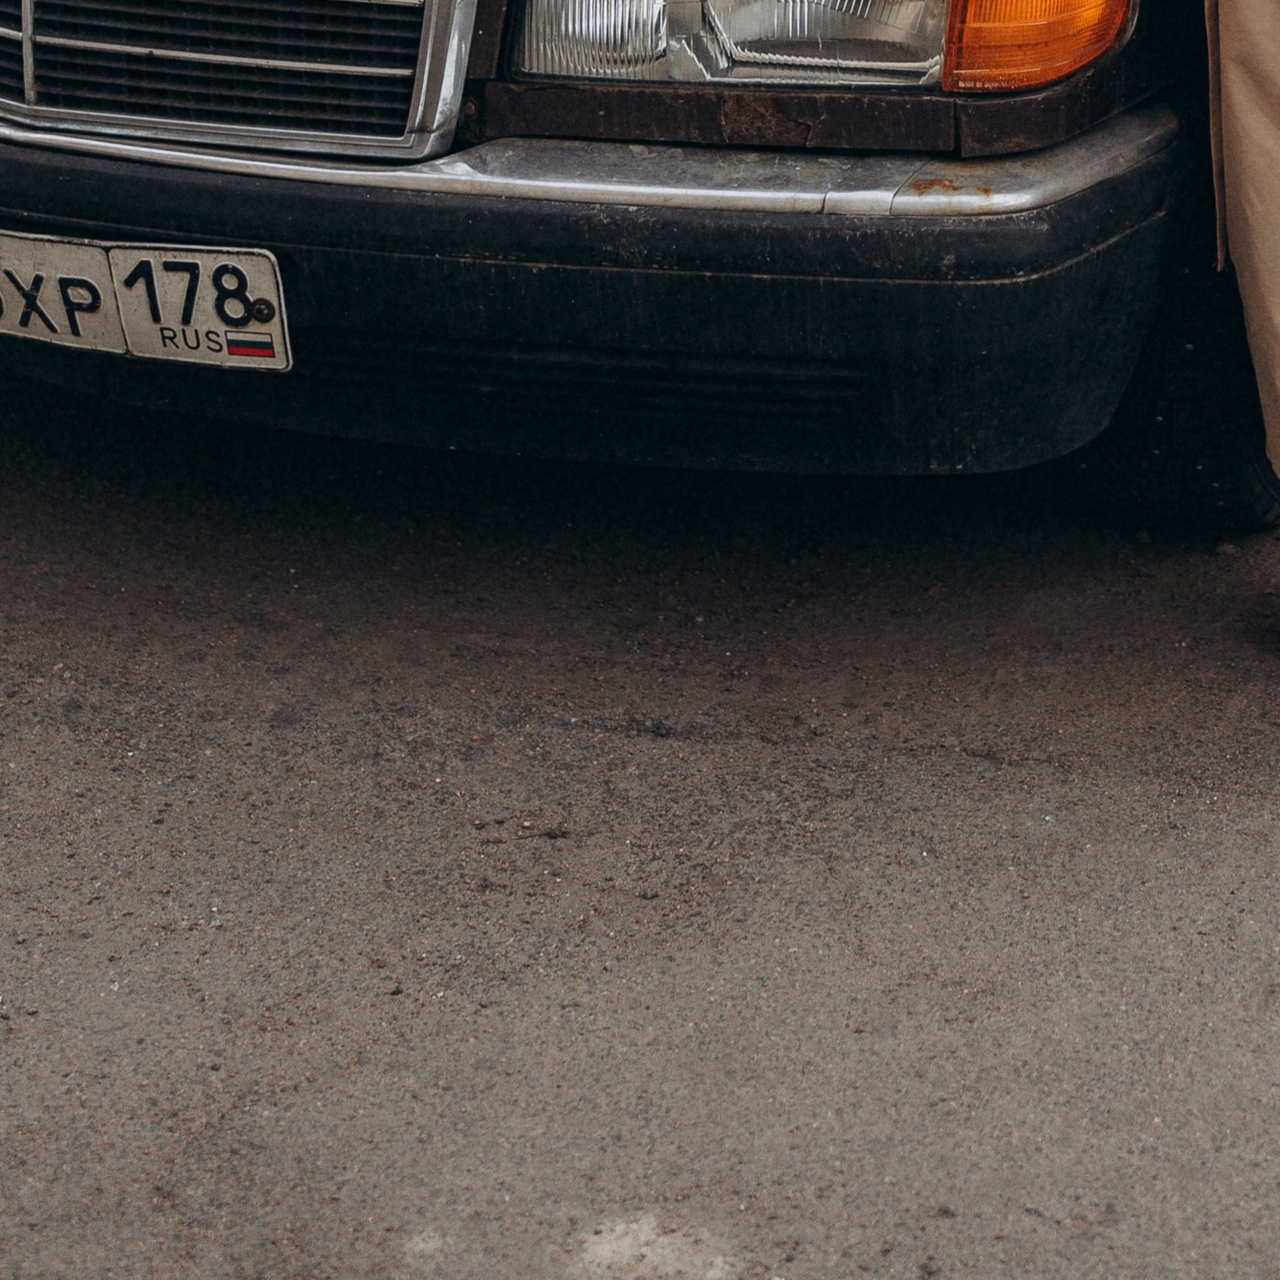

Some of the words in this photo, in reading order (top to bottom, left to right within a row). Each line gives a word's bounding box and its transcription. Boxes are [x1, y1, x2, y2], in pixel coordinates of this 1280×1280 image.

[0, 269, 101, 336] XP
[123, 259, 253, 327] 178
[159, 327, 223, 352] RUS
